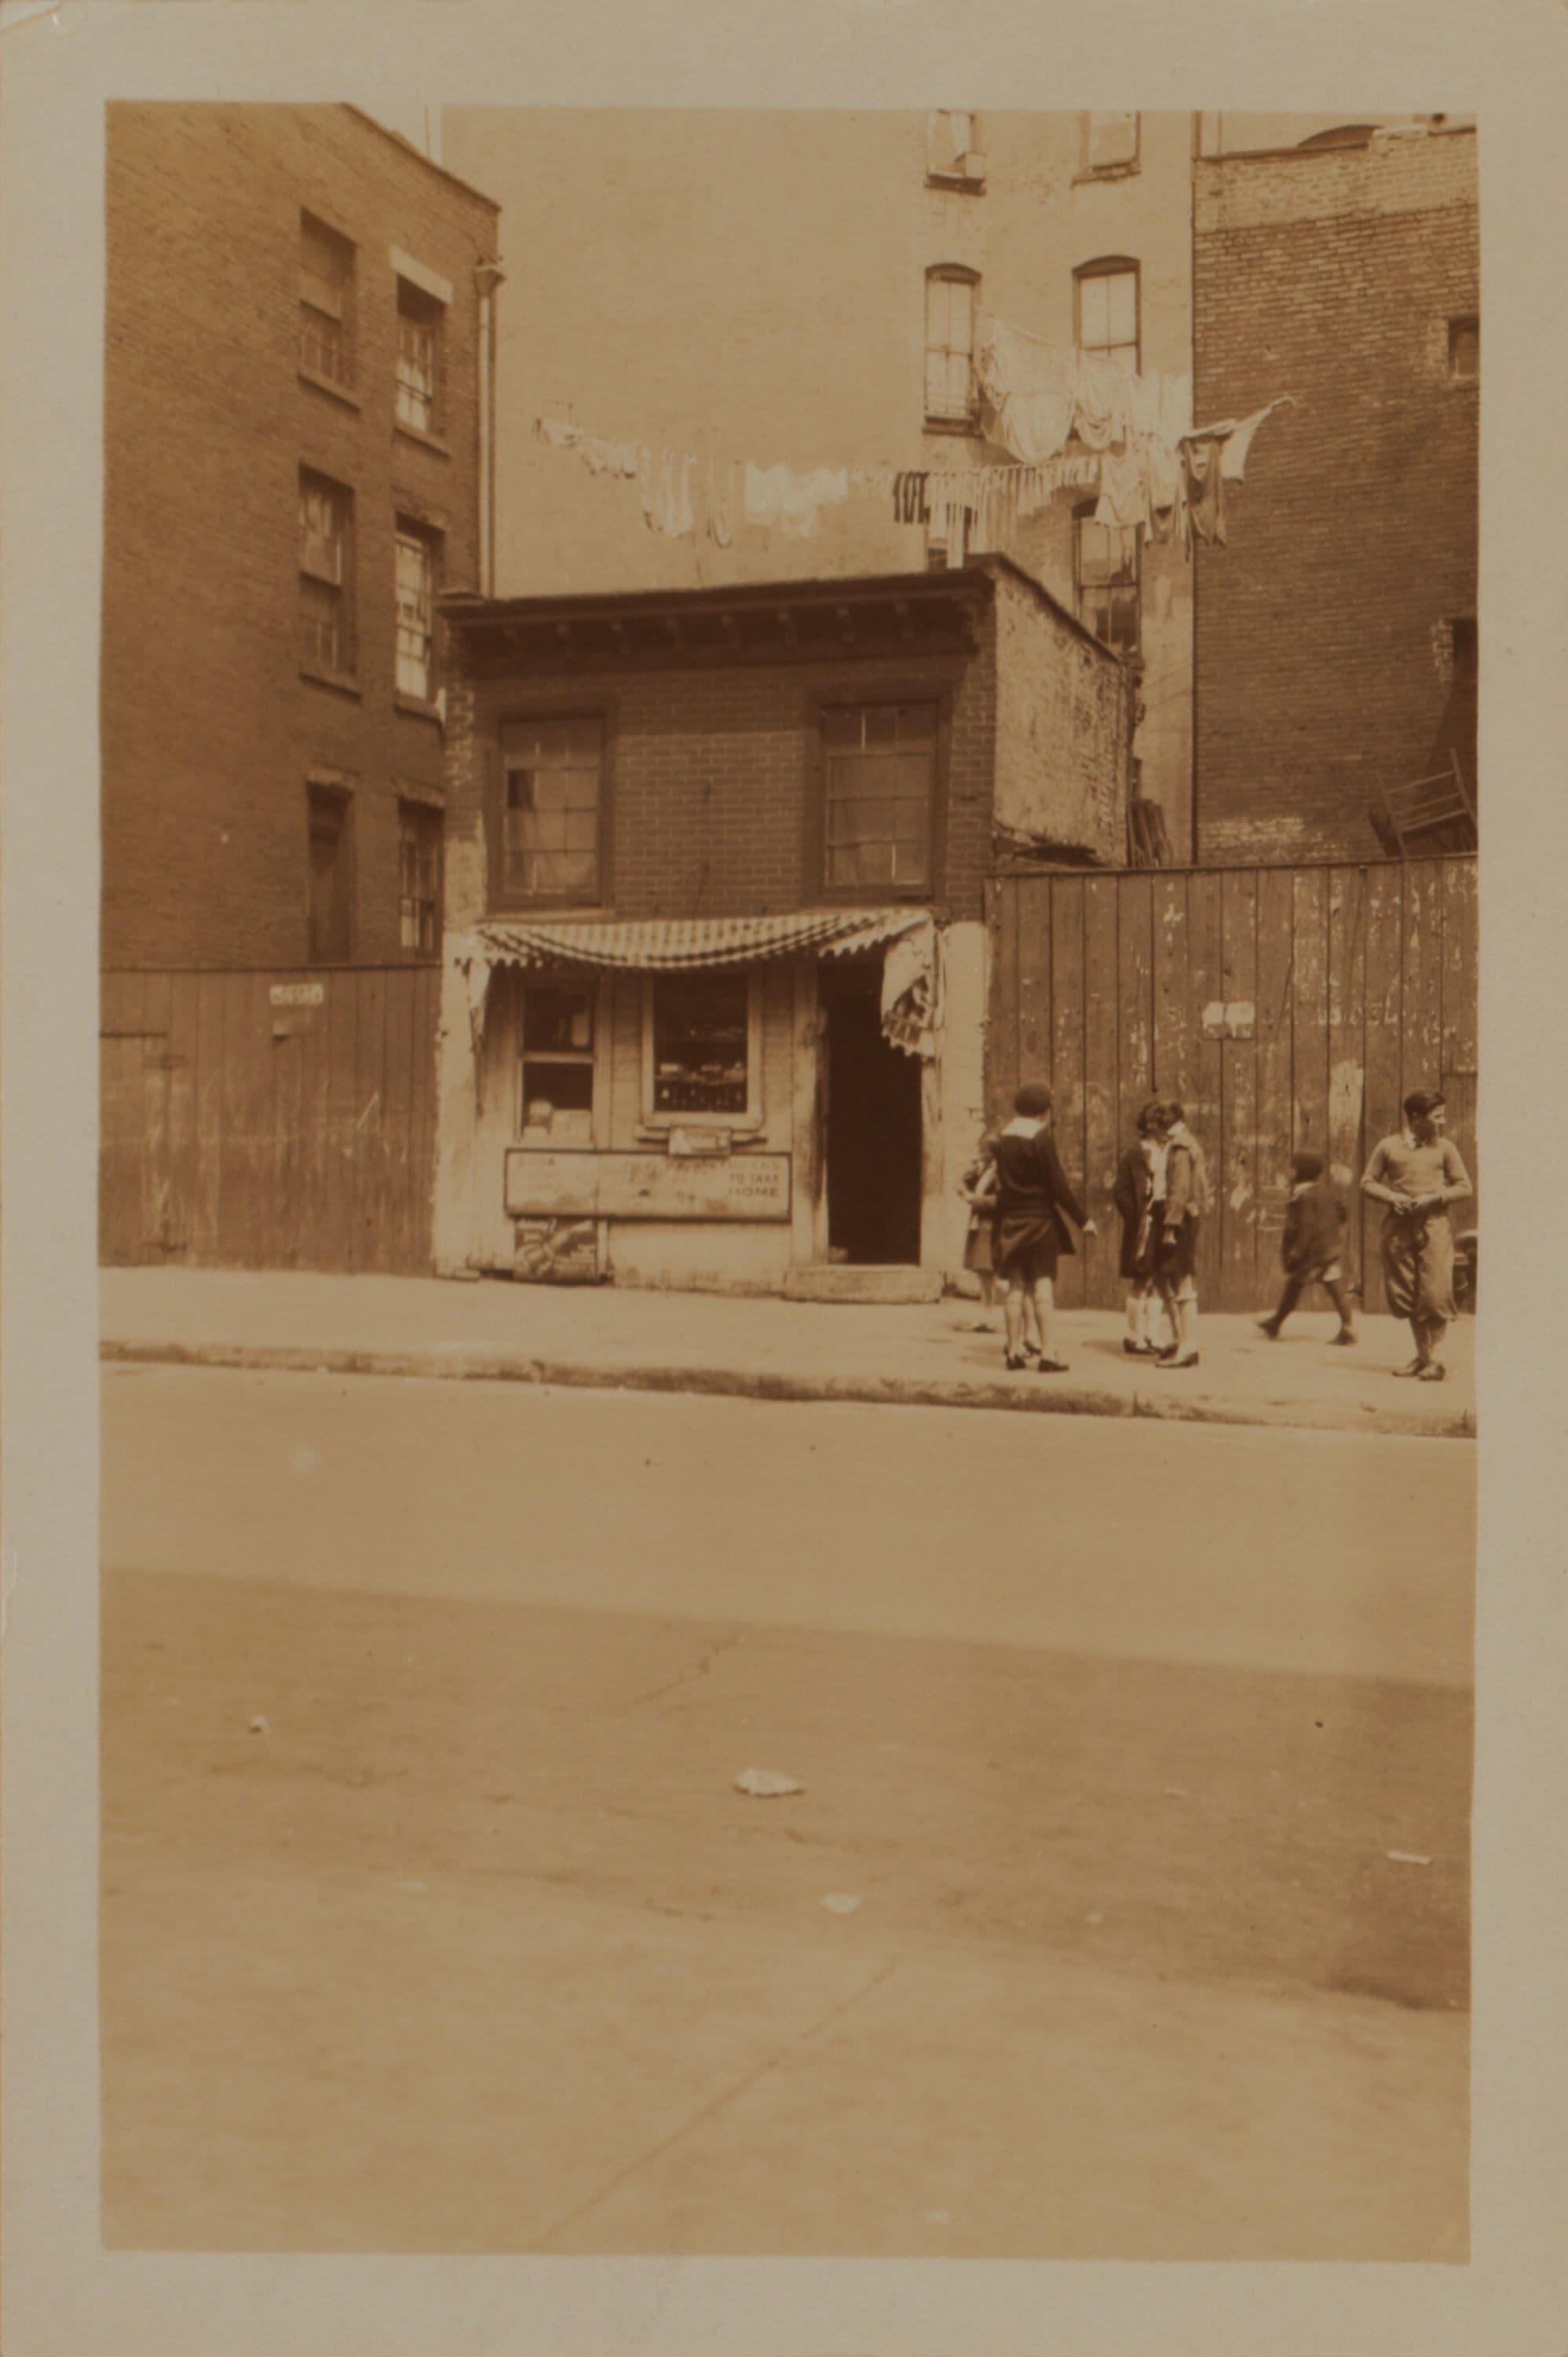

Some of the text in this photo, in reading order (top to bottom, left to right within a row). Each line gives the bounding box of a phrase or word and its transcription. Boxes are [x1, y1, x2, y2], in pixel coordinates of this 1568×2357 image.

[729, 1173, 779, 1184] TO TAKE
[729, 1187, 779, 1198] HOME
